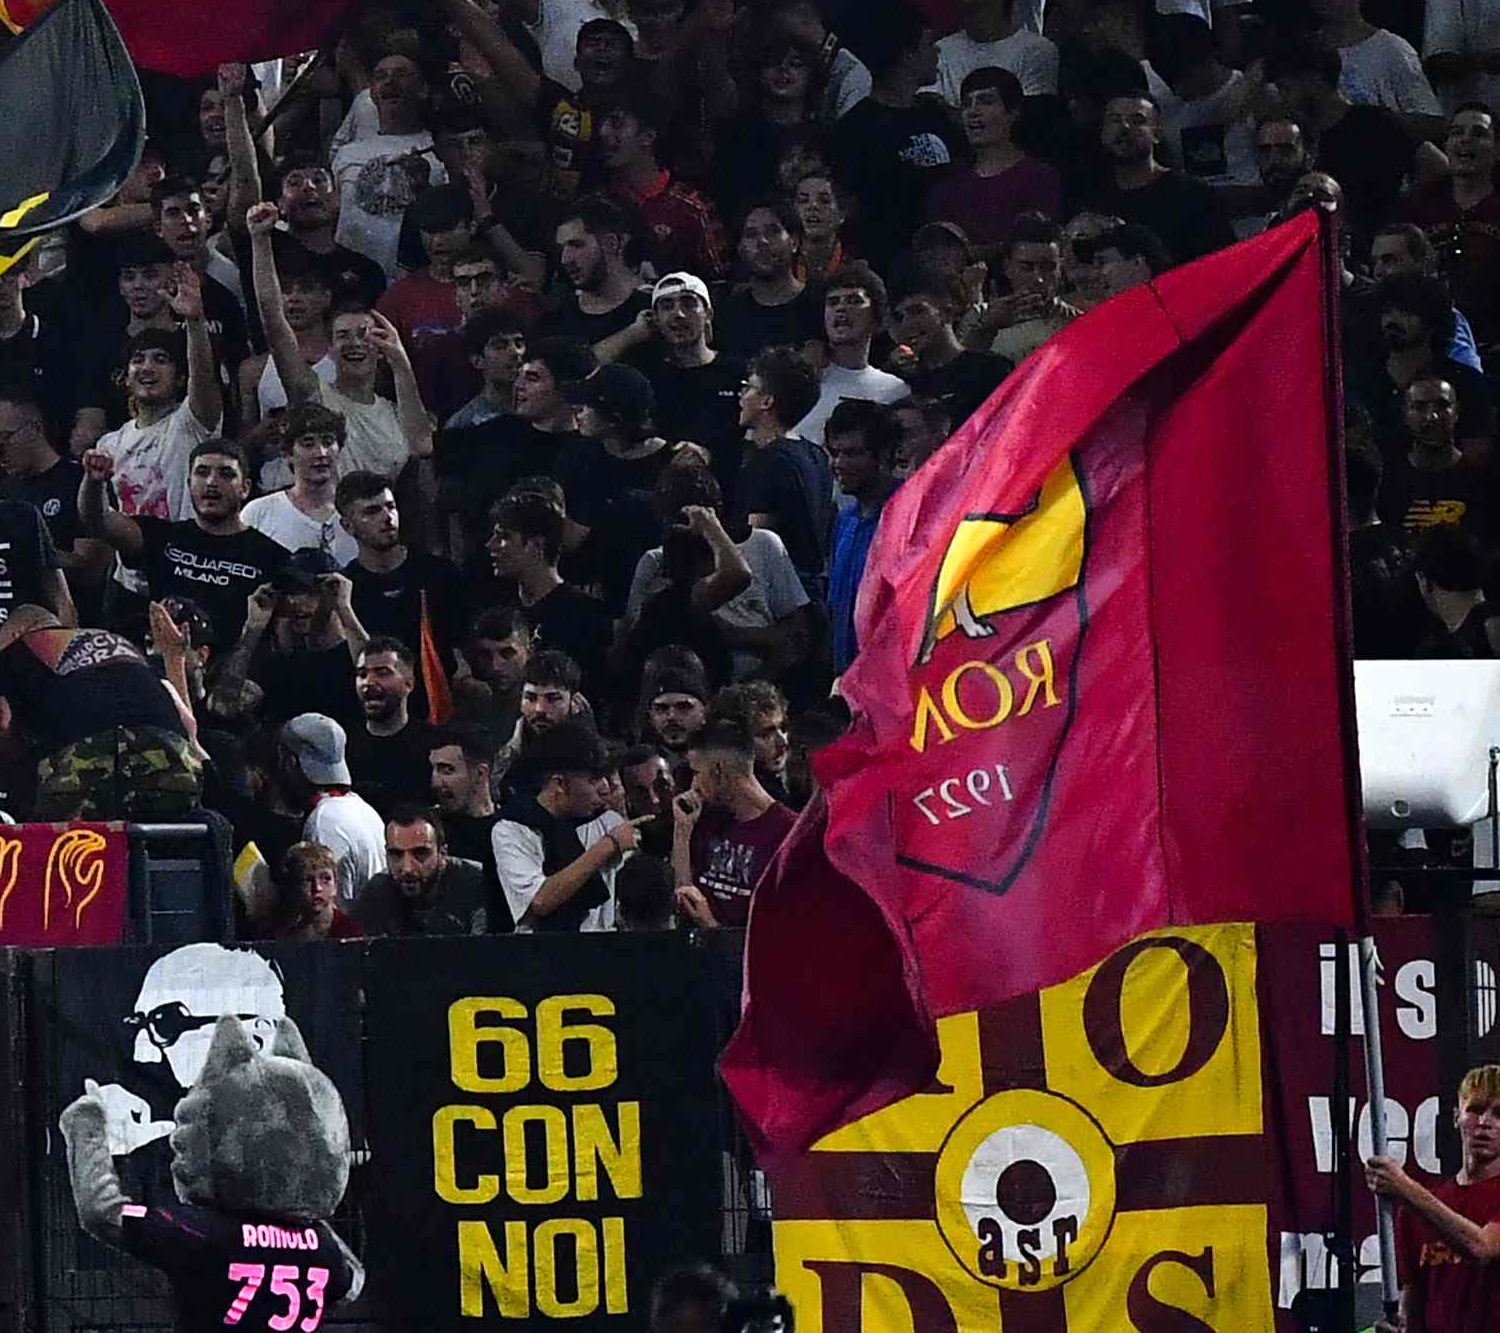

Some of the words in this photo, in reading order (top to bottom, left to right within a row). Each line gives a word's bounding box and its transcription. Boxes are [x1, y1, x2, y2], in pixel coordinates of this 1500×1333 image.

[173, 565, 251, 587] MILANO
[446, 994, 619, 1095] 66
[431, 1100, 644, 1206] CON
[241, 1223, 320, 1251] ROMOLO
[458, 1216, 630, 1322] NOI
[977, 1216, 1079, 1286] asr
[222, 1261, 331, 1333] 753
